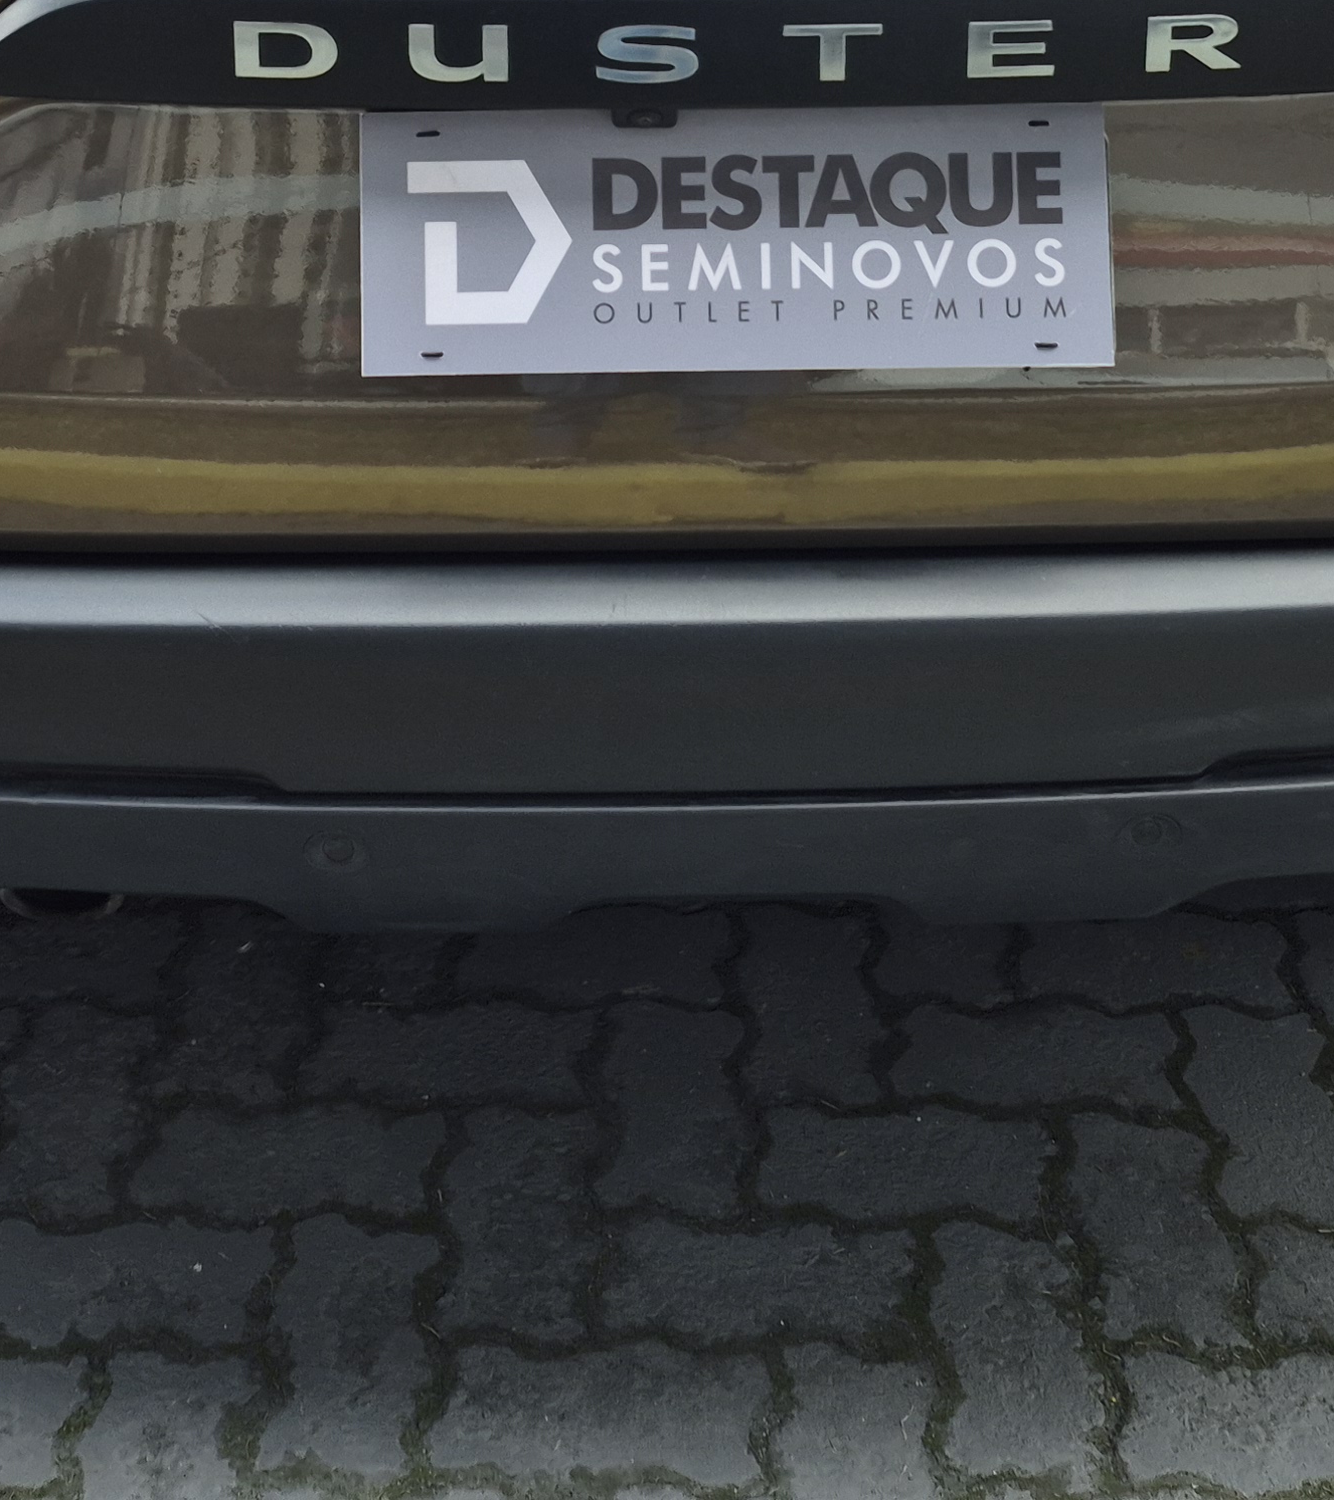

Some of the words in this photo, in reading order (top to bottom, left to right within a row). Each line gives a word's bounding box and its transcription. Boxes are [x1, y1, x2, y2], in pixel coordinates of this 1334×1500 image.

[232, 14, 1241, 83] DUSTER
[592, 152, 1063, 235] DESTAQUE
[592, 238, 1067, 294] SEMINOVOS
[594, 300, 784, 325] OUTLET
[833, 297, 1069, 322] PREMIUM
